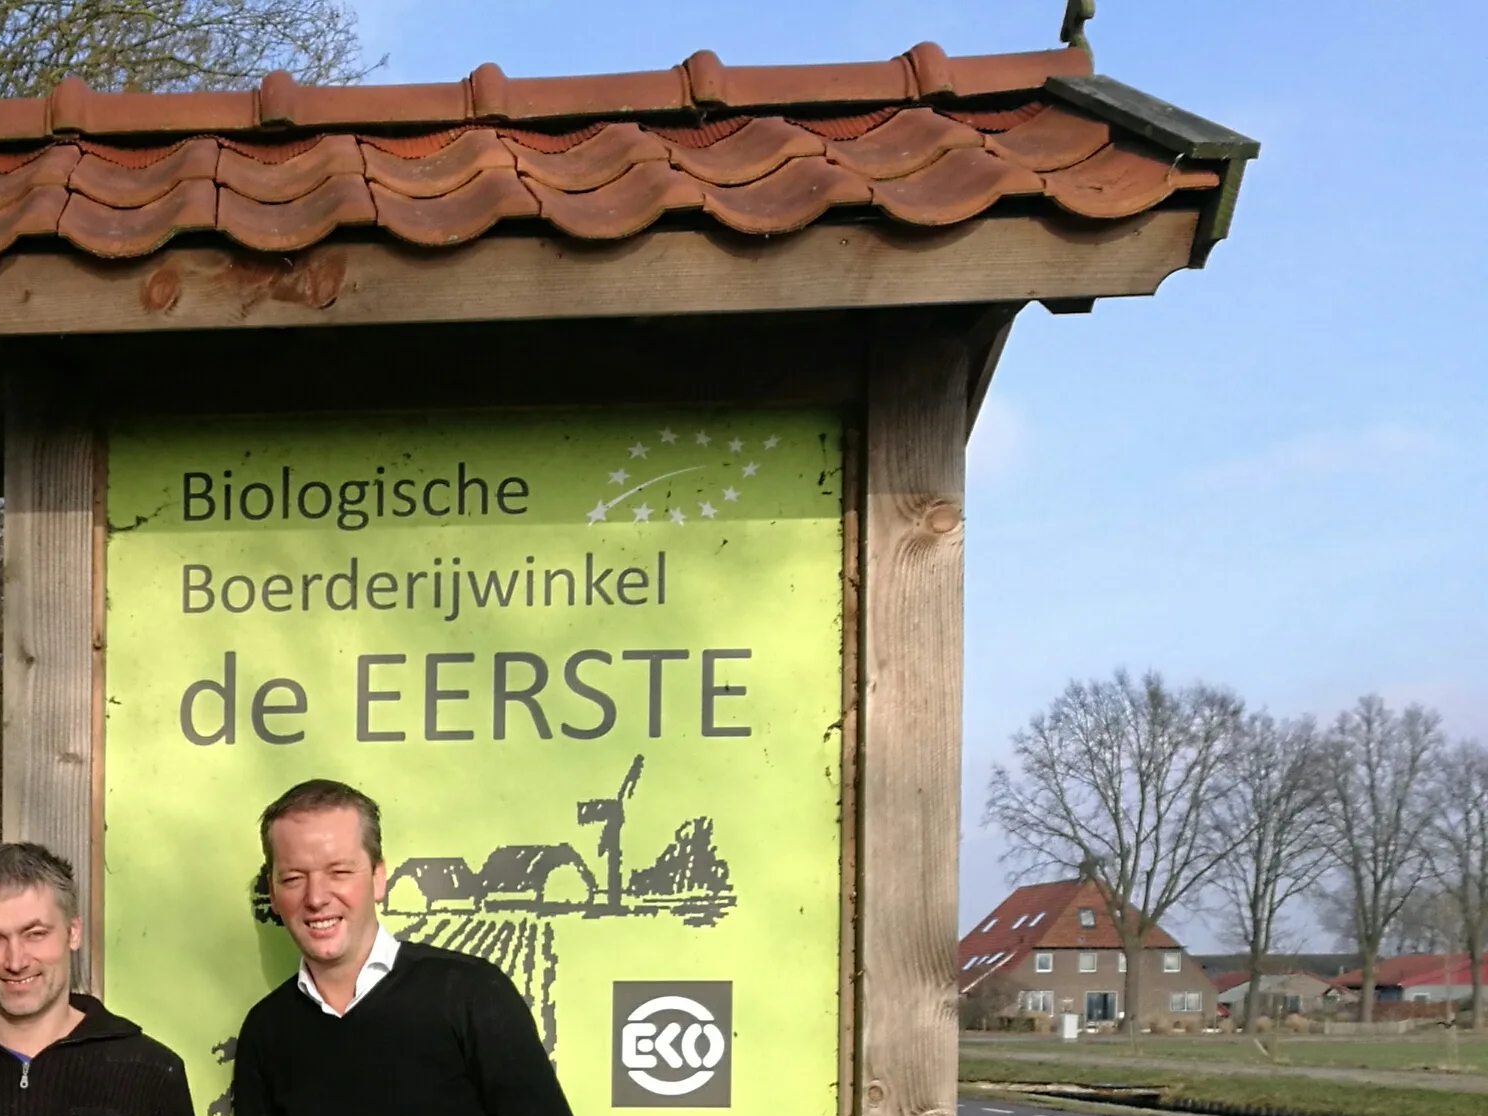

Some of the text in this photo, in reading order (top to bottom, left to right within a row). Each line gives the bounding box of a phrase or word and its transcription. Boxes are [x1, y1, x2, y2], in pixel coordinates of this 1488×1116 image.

[181, 462, 531, 531] Biologische
[181, 552, 667, 621] Boerderijwinkel
[179, 648, 753, 746] de EERSTE
[622, 1022, 725, 1069] EKO
